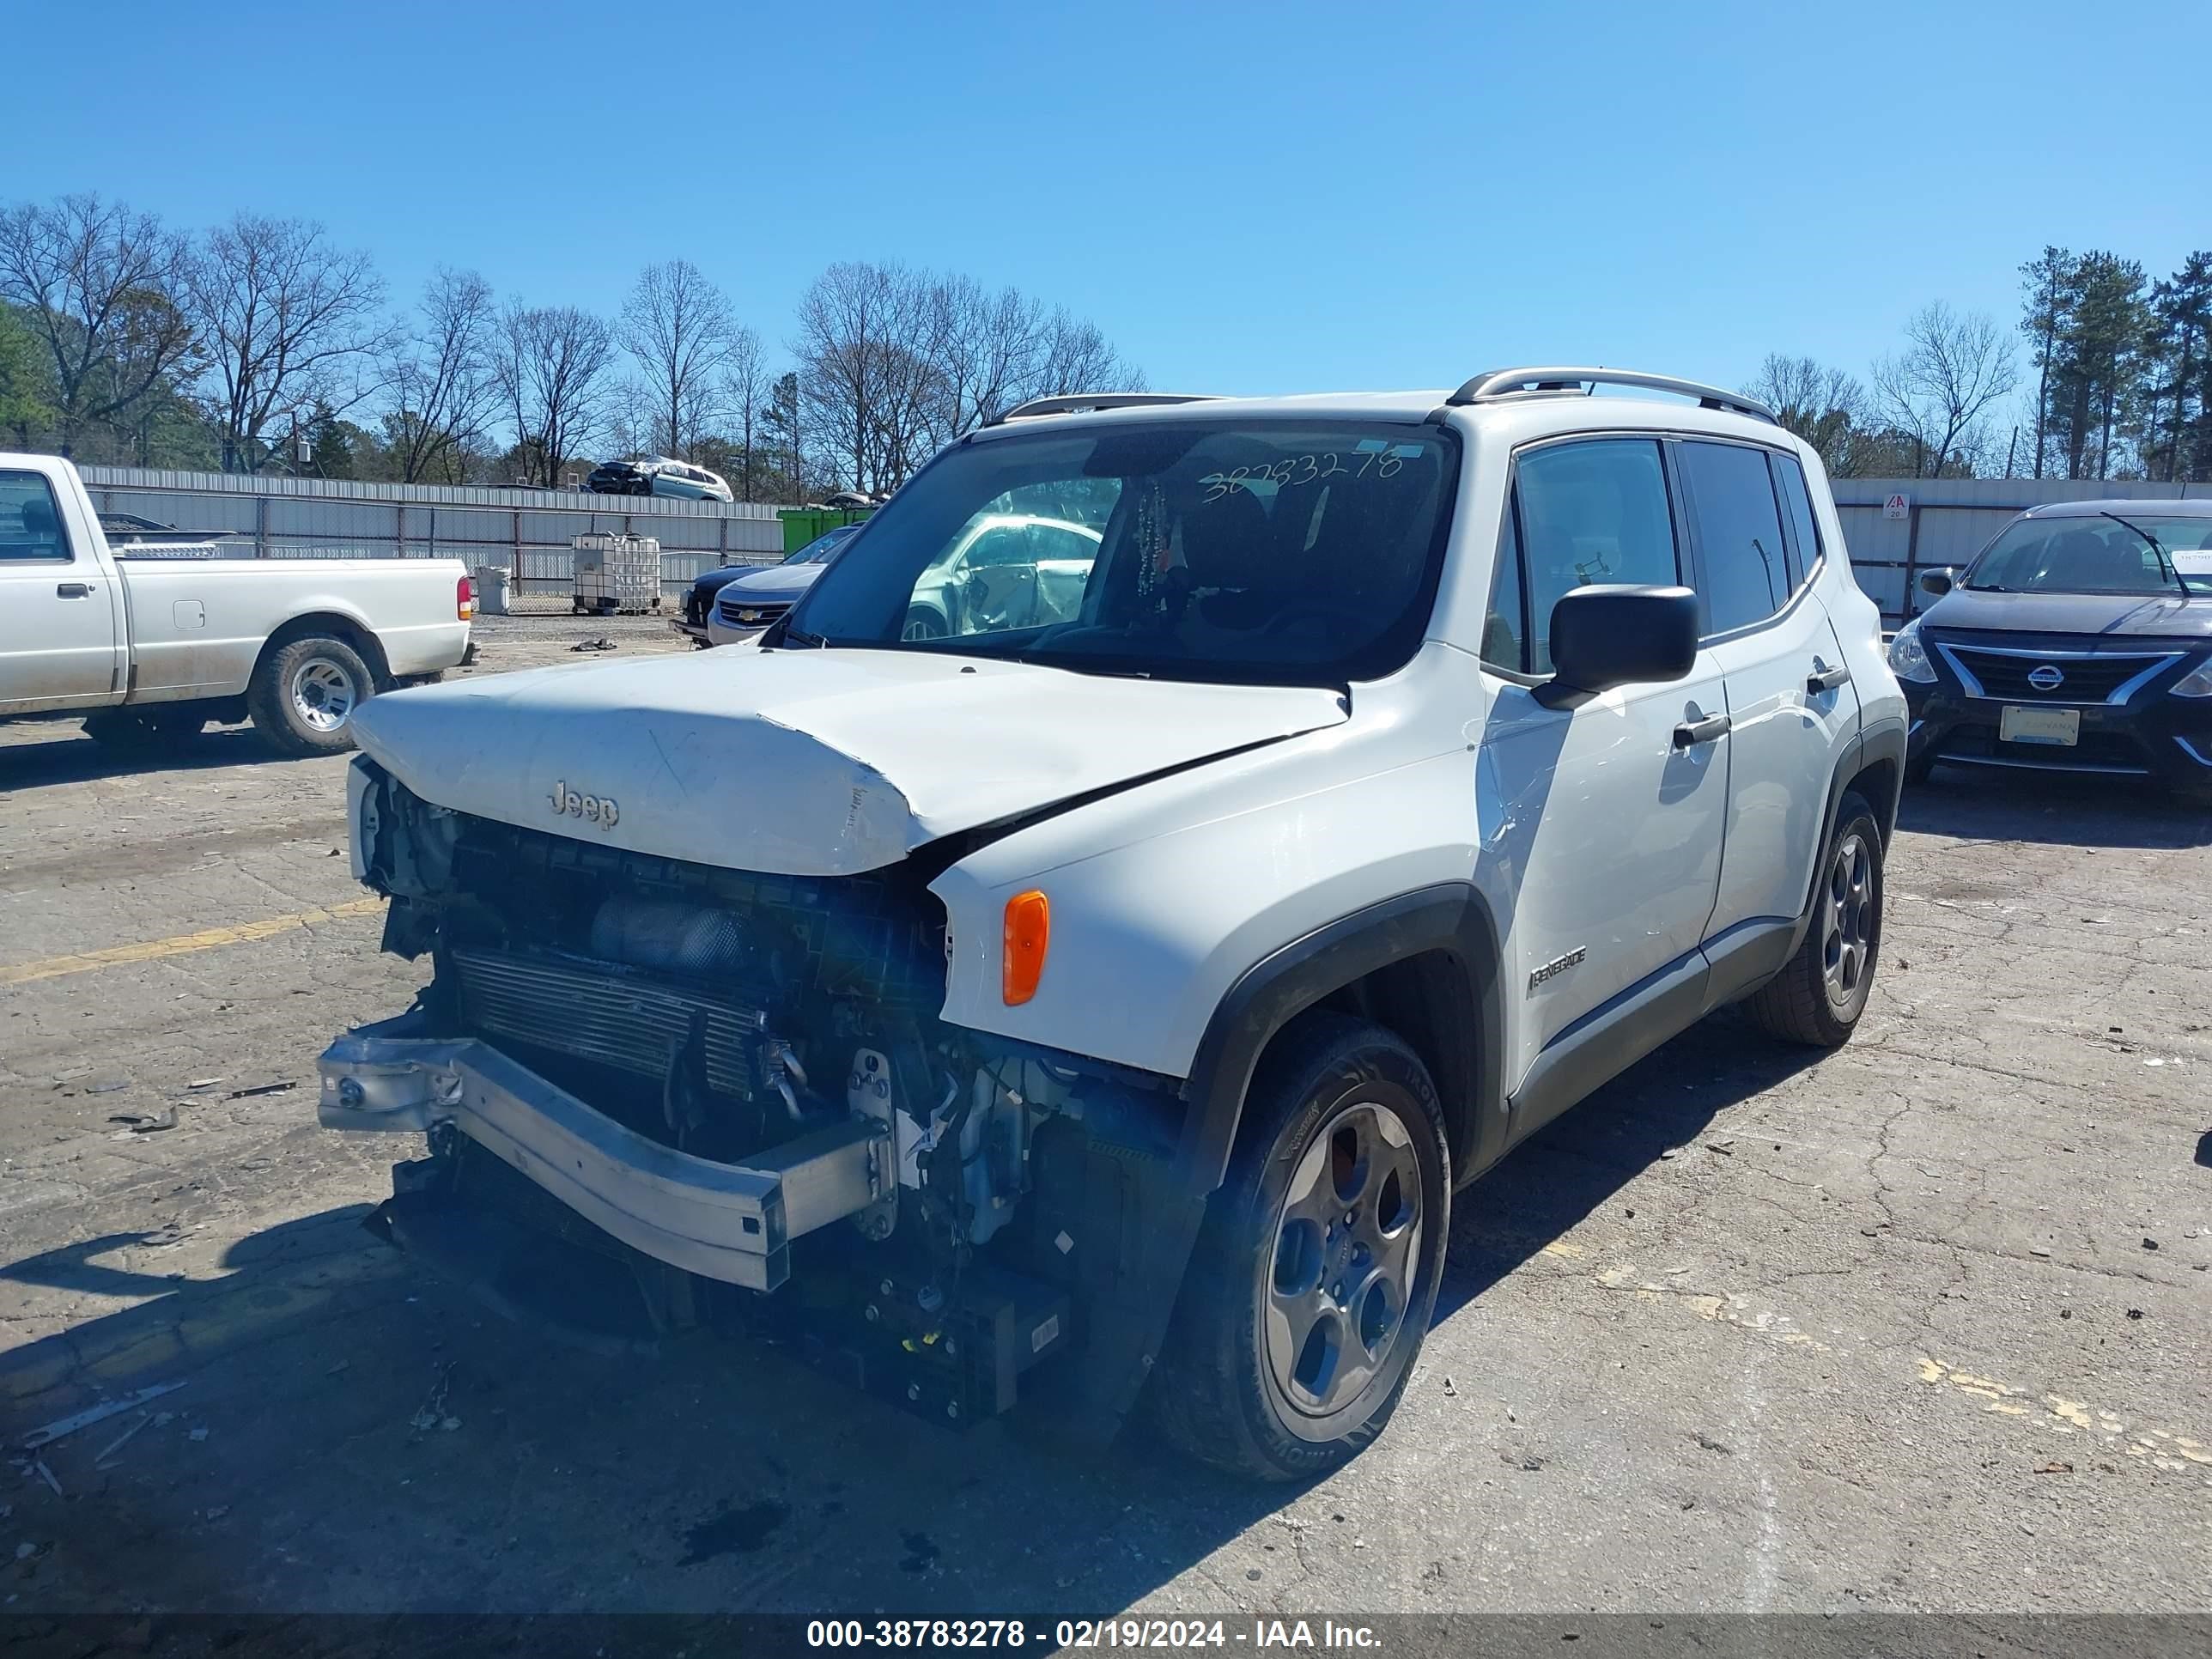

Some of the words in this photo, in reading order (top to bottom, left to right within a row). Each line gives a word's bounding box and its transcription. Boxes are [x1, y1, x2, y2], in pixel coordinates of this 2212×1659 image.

[1202, 449, 1404, 503] 38783278
[547, 780, 619, 831] Jeep
[1529, 945, 1586, 990] RENEGADE
